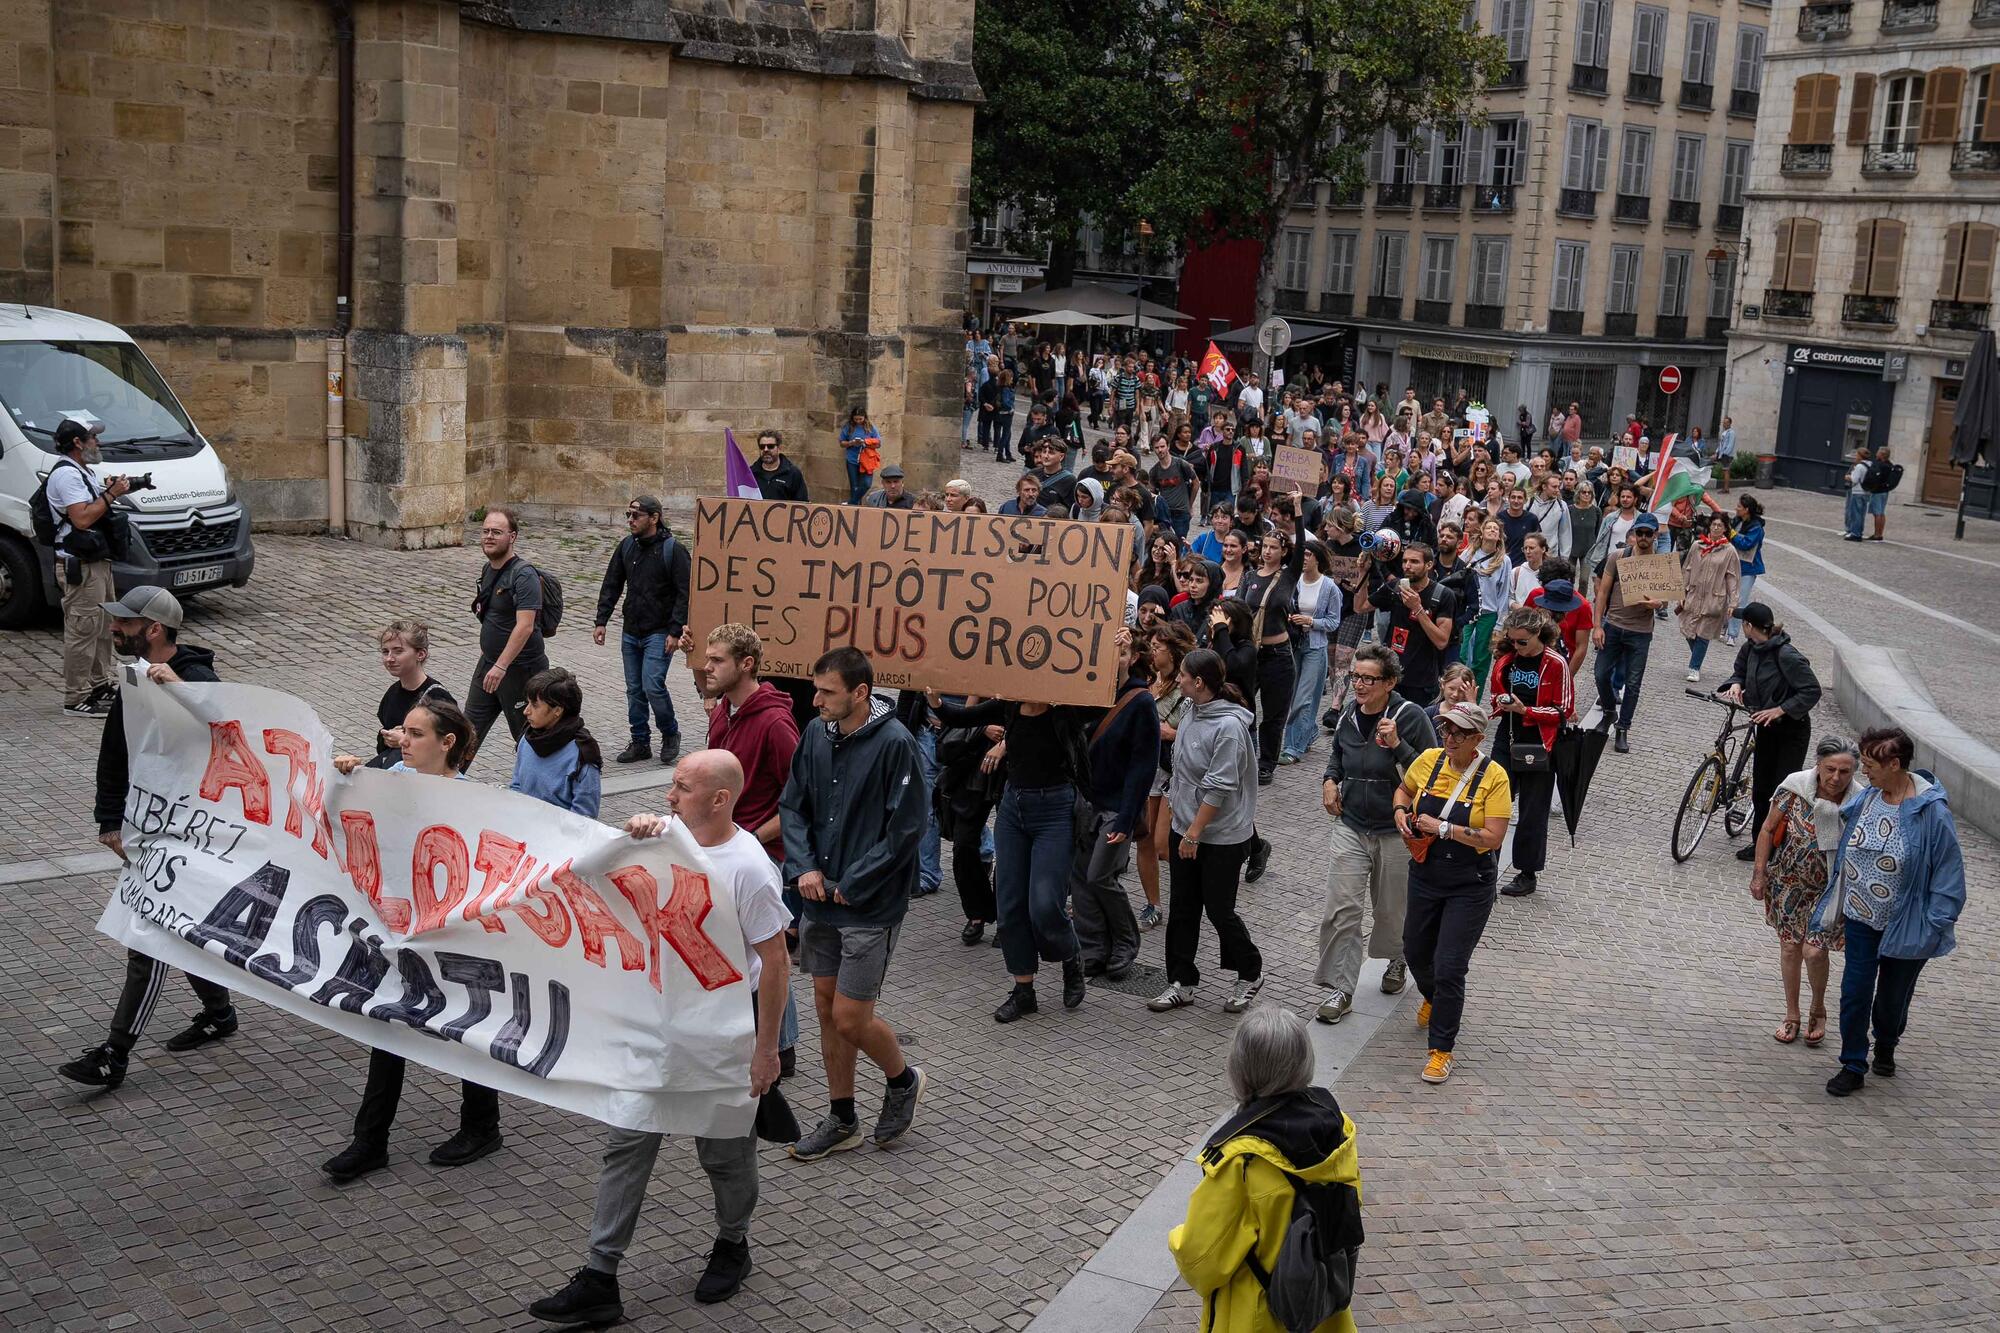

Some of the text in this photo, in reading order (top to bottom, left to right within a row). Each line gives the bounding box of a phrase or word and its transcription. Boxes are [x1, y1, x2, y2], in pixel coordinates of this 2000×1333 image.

[1420, 347, 1451, 360] MAISON
[1812, 350, 1884, 367] CRÉDIT AGRICOLE
[1276, 464, 1309, 480] TRANS
[140, 488, 226, 504] Construction-Démolition
[696, 500, 860, 550] MACRON
[1623, 560, 1661, 572] STOP AU
[1620, 571, 1664, 583] GAVAGE DES
[697, 554, 1112, 621] DES IMPÔTS POUR
[1621, 582, 1672, 595] ULTRA RICHES
[823, 604, 928, 663] PLUS
[948, 615, 1105, 683] GROS!
[774, 660, 803, 675] SONT
[135, 839, 188, 893] NOS
